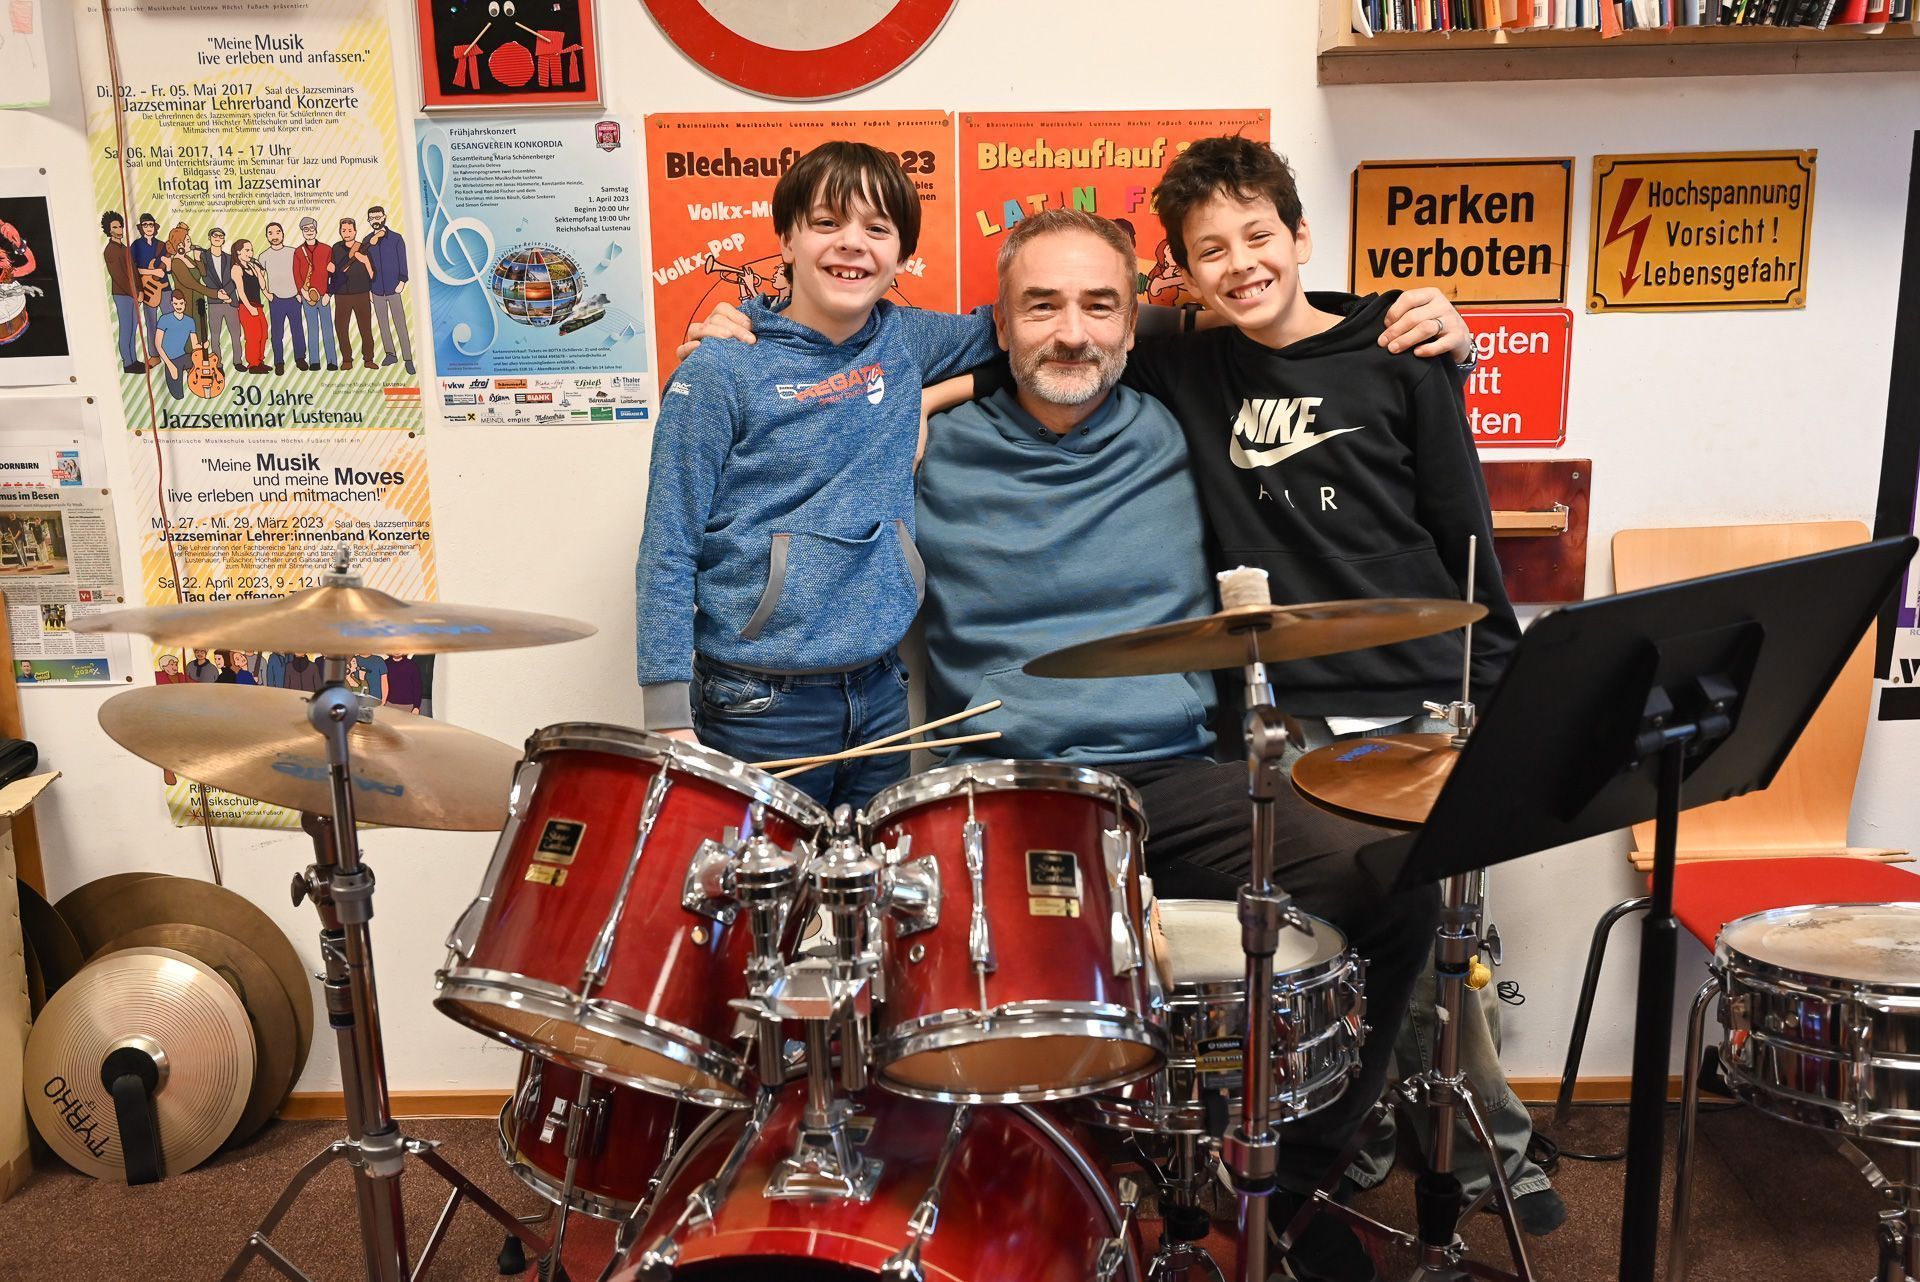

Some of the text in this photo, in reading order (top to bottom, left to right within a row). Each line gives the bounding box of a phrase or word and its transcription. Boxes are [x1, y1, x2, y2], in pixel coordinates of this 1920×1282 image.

[208, 34, 304, 50] "Meine Musik
[198, 50, 370, 65] live erleben und anfassen."
[97, 85, 113, 98] Di.
[152, 85, 166, 97] Fr.
[170, 85, 189, 97] 05.
[194, 84, 217, 96] Mai
[222, 84, 252, 96] 2017
[265, 86, 283, 95] Saal
[285, 86, 300, 94] des
[302, 86, 355, 95] Jazzseminars
[122, 95, 359, 112] Jazzseminar Lehrerband Konzerte
[450, 128, 517, 138] Frühjahrskonzert
[736, 121, 782, 129] Musikschule
[126, 147, 146, 159] 06.
[150, 146, 173, 158] Mai
[178, 146, 213, 160] 2017,
[218, 146, 233, 157] 14
[250, 145, 264, 157] 17
[269, 144, 291, 157] Uhr
[451, 140, 563, 151] GESANGVEREIN KONKORDIA
[977, 137, 1167, 170] Blechauflauf
[126, 155, 378, 168] Saal und Unterrichtsräume im Seminar für Jazz und Popmusik
[452, 154, 494, 162] Gesamtleitung
[512, 153, 555, 161] Schönenberger
[183, 168, 220, 178] Bildgasse
[239, 167, 276, 176] Lustenau
[158, 175, 321, 194] Infotag im Jazzseminar
[601, 186, 628, 194] Samstag
[1648, 179, 1801, 212] Hochspannung
[574, 206, 597, 214] Beginn
[687, 200, 774, 221] Volkx-M
[976, 186, 1097, 237] LATN
[1387, 184, 1535, 226] Parken
[554, 216, 598, 224] Sektempfang
[556, 224, 631, 233] Reichshofsaal Lustenau
[1666, 217, 1765, 247] Vorsicht
[652, 232, 745, 286] Volkx-Pop
[1367, 237, 1552, 279] verboten
[905, 257, 927, 278] ck
[1643, 255, 1797, 292] Lebensgefahr
[1470, 325, 1550, 361] gten
[1469, 366, 1502, 395] itt
[231, 385, 314, 406] 30 Jahre
[527, 393, 551, 401] BLANK
[160, 409, 363, 429] Jazzseminar Lustenau
[1233, 397, 1324, 444] NIKE
[1468, 406, 1522, 435] ten
[201, 453, 320, 472] "Meine Musik
[253, 467, 404, 486] und meine Moves
[18, 491, 30, 500] im
[32, 491, 60, 500] Besen
[168, 487, 386, 502] live erleben und mitmachen!"
[178, 517, 198, 529] 27.
[211, 517, 229, 528] Mi.
[233, 517, 252, 528] 29.
[257, 516, 287, 528] März
[292, 516, 324, 528] 2023
[335, 519, 353, 528] Saal
[355, 519, 371, 528] des
[373, 519, 430, 528] Jazzseminars
[159, 529, 430, 543] Jazzseminar Lehrer:innenband Konzerte
[182, 577, 200, 589] 22.
[205, 576, 234, 591] April
[237, 576, 272, 591] 2023,
[276, 576, 284, 588] 9
[298, 576, 313, 588] 12
[182, 590, 285, 603] Tag der offenen
[190, 796, 259, 807] Msikschule
